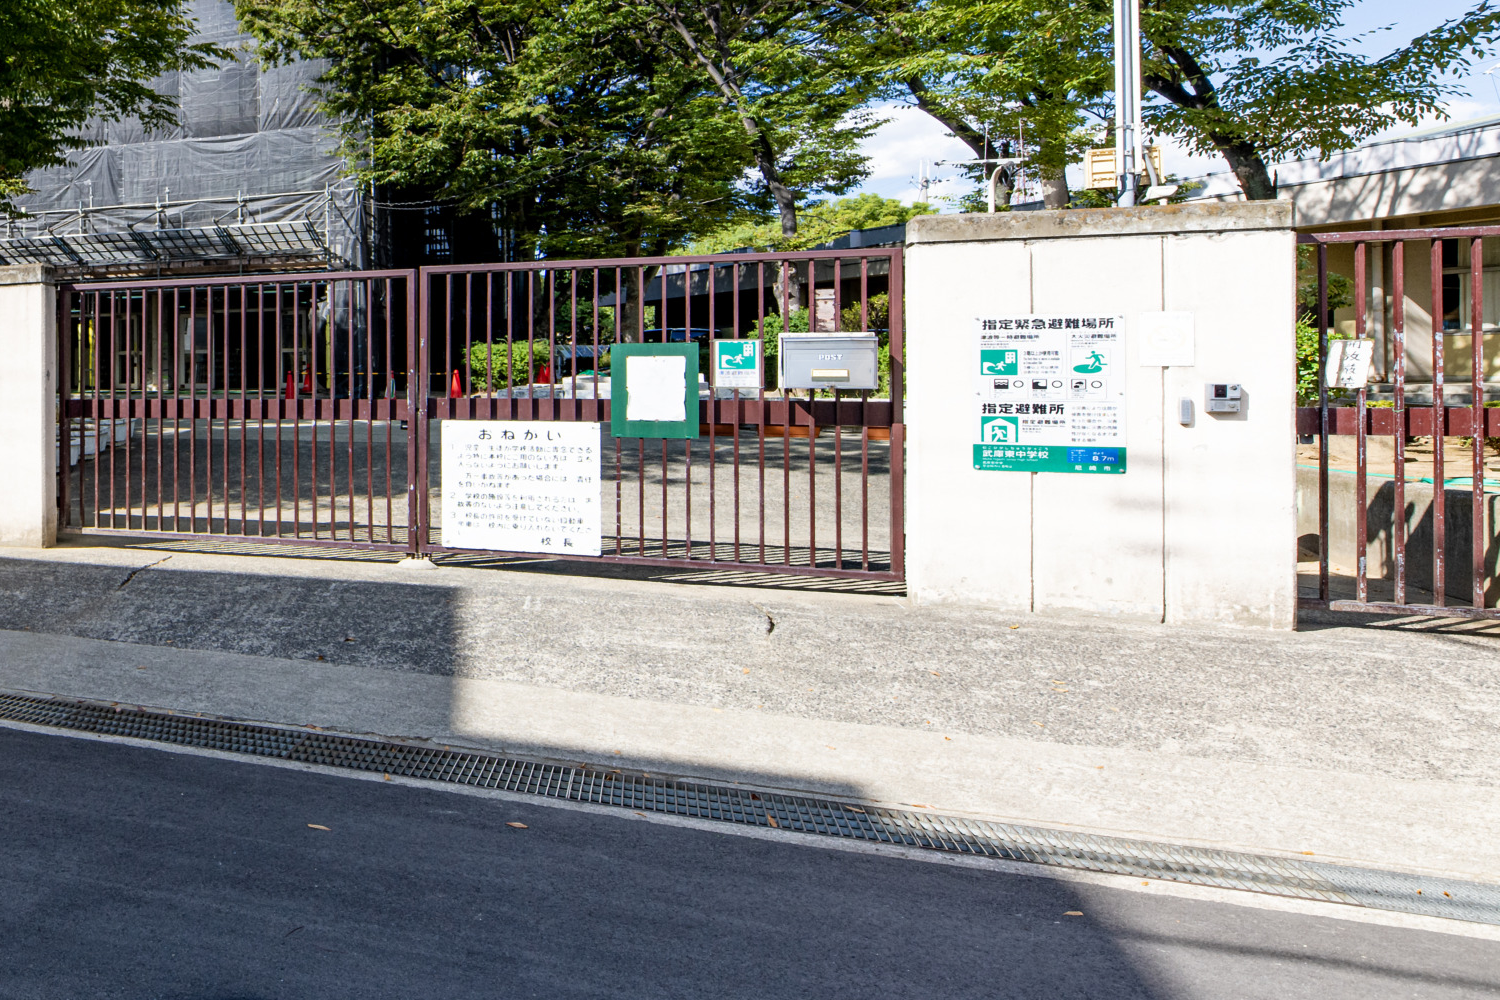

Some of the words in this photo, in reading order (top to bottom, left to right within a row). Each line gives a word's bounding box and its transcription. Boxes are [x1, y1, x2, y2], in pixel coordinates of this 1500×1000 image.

[982, 317, 1114, 331] 指定緊急避難場所
[982, 403, 1065, 415] 指定避難所
[982, 450, 1049, 459] 武庫東中学校
